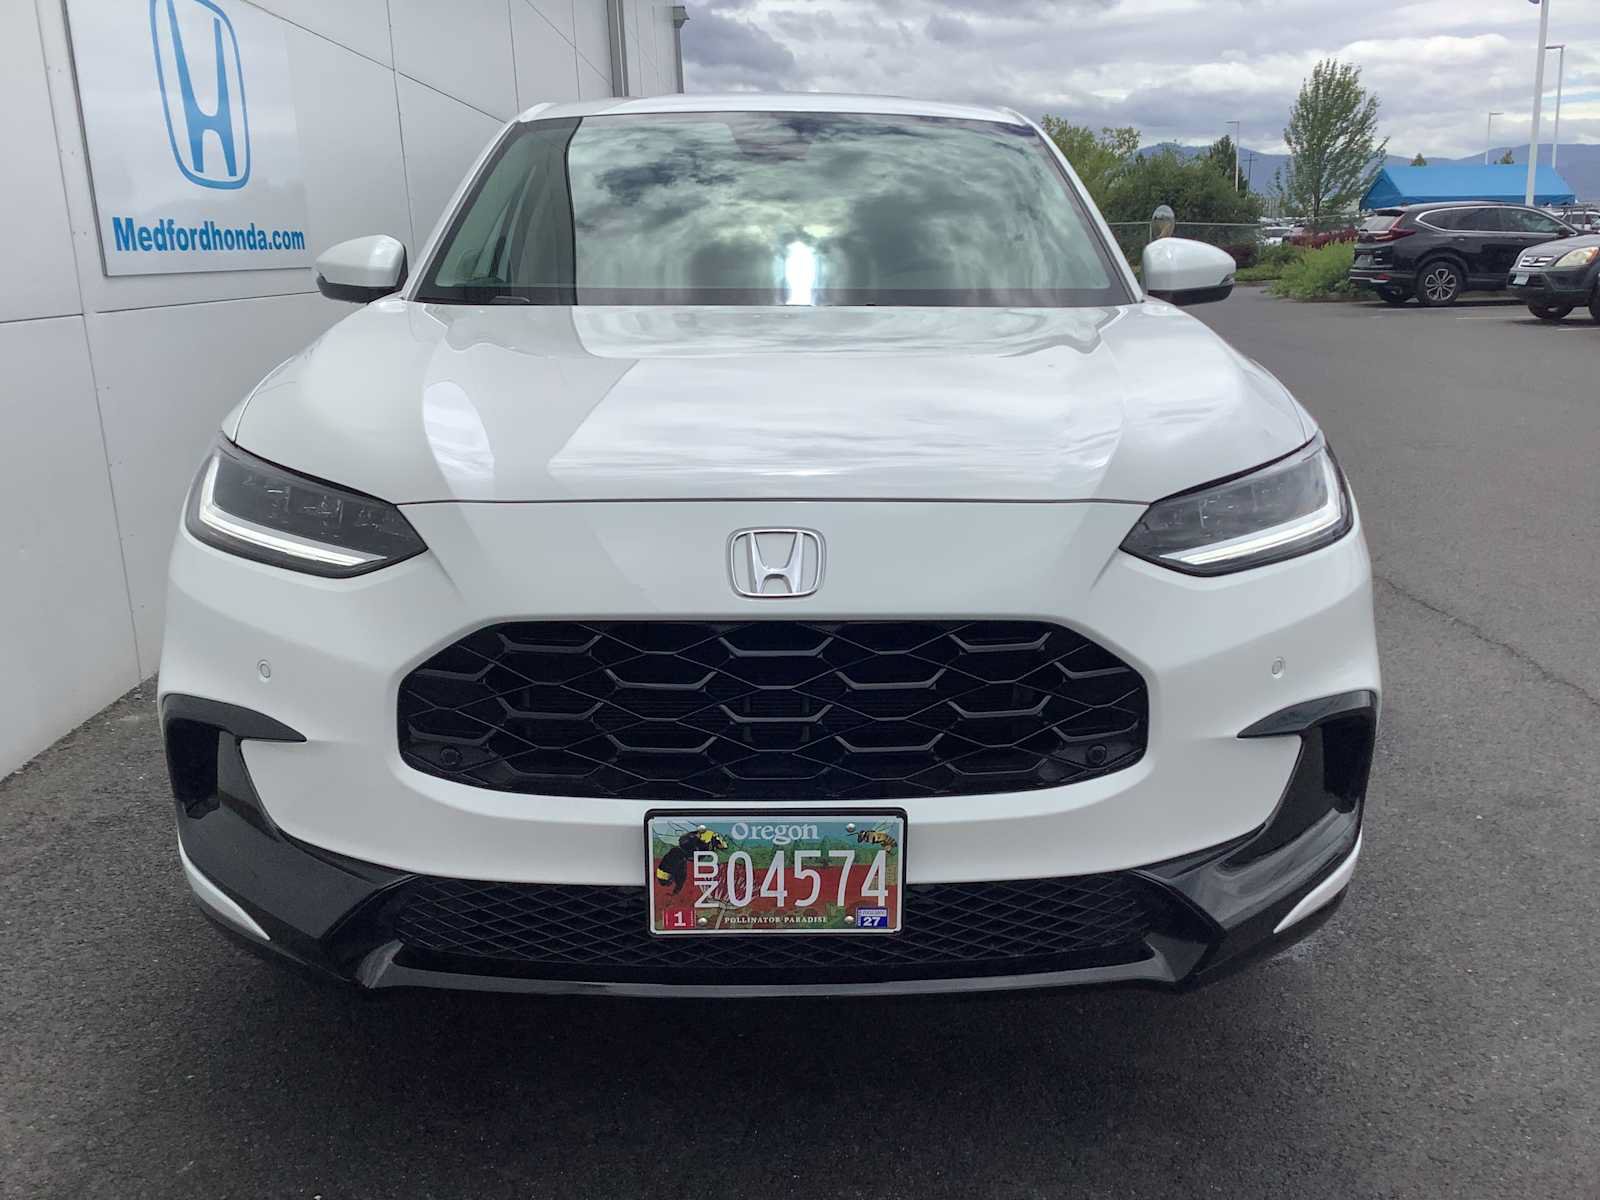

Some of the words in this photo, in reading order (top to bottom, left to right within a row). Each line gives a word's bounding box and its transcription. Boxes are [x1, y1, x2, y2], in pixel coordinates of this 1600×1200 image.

[112, 216, 305, 251] Medfordhonda.com
[731, 822, 819, 845] Oregon
[724, 916, 781, 924] POLLINATOR
[863, 916, 881, 927] 27
